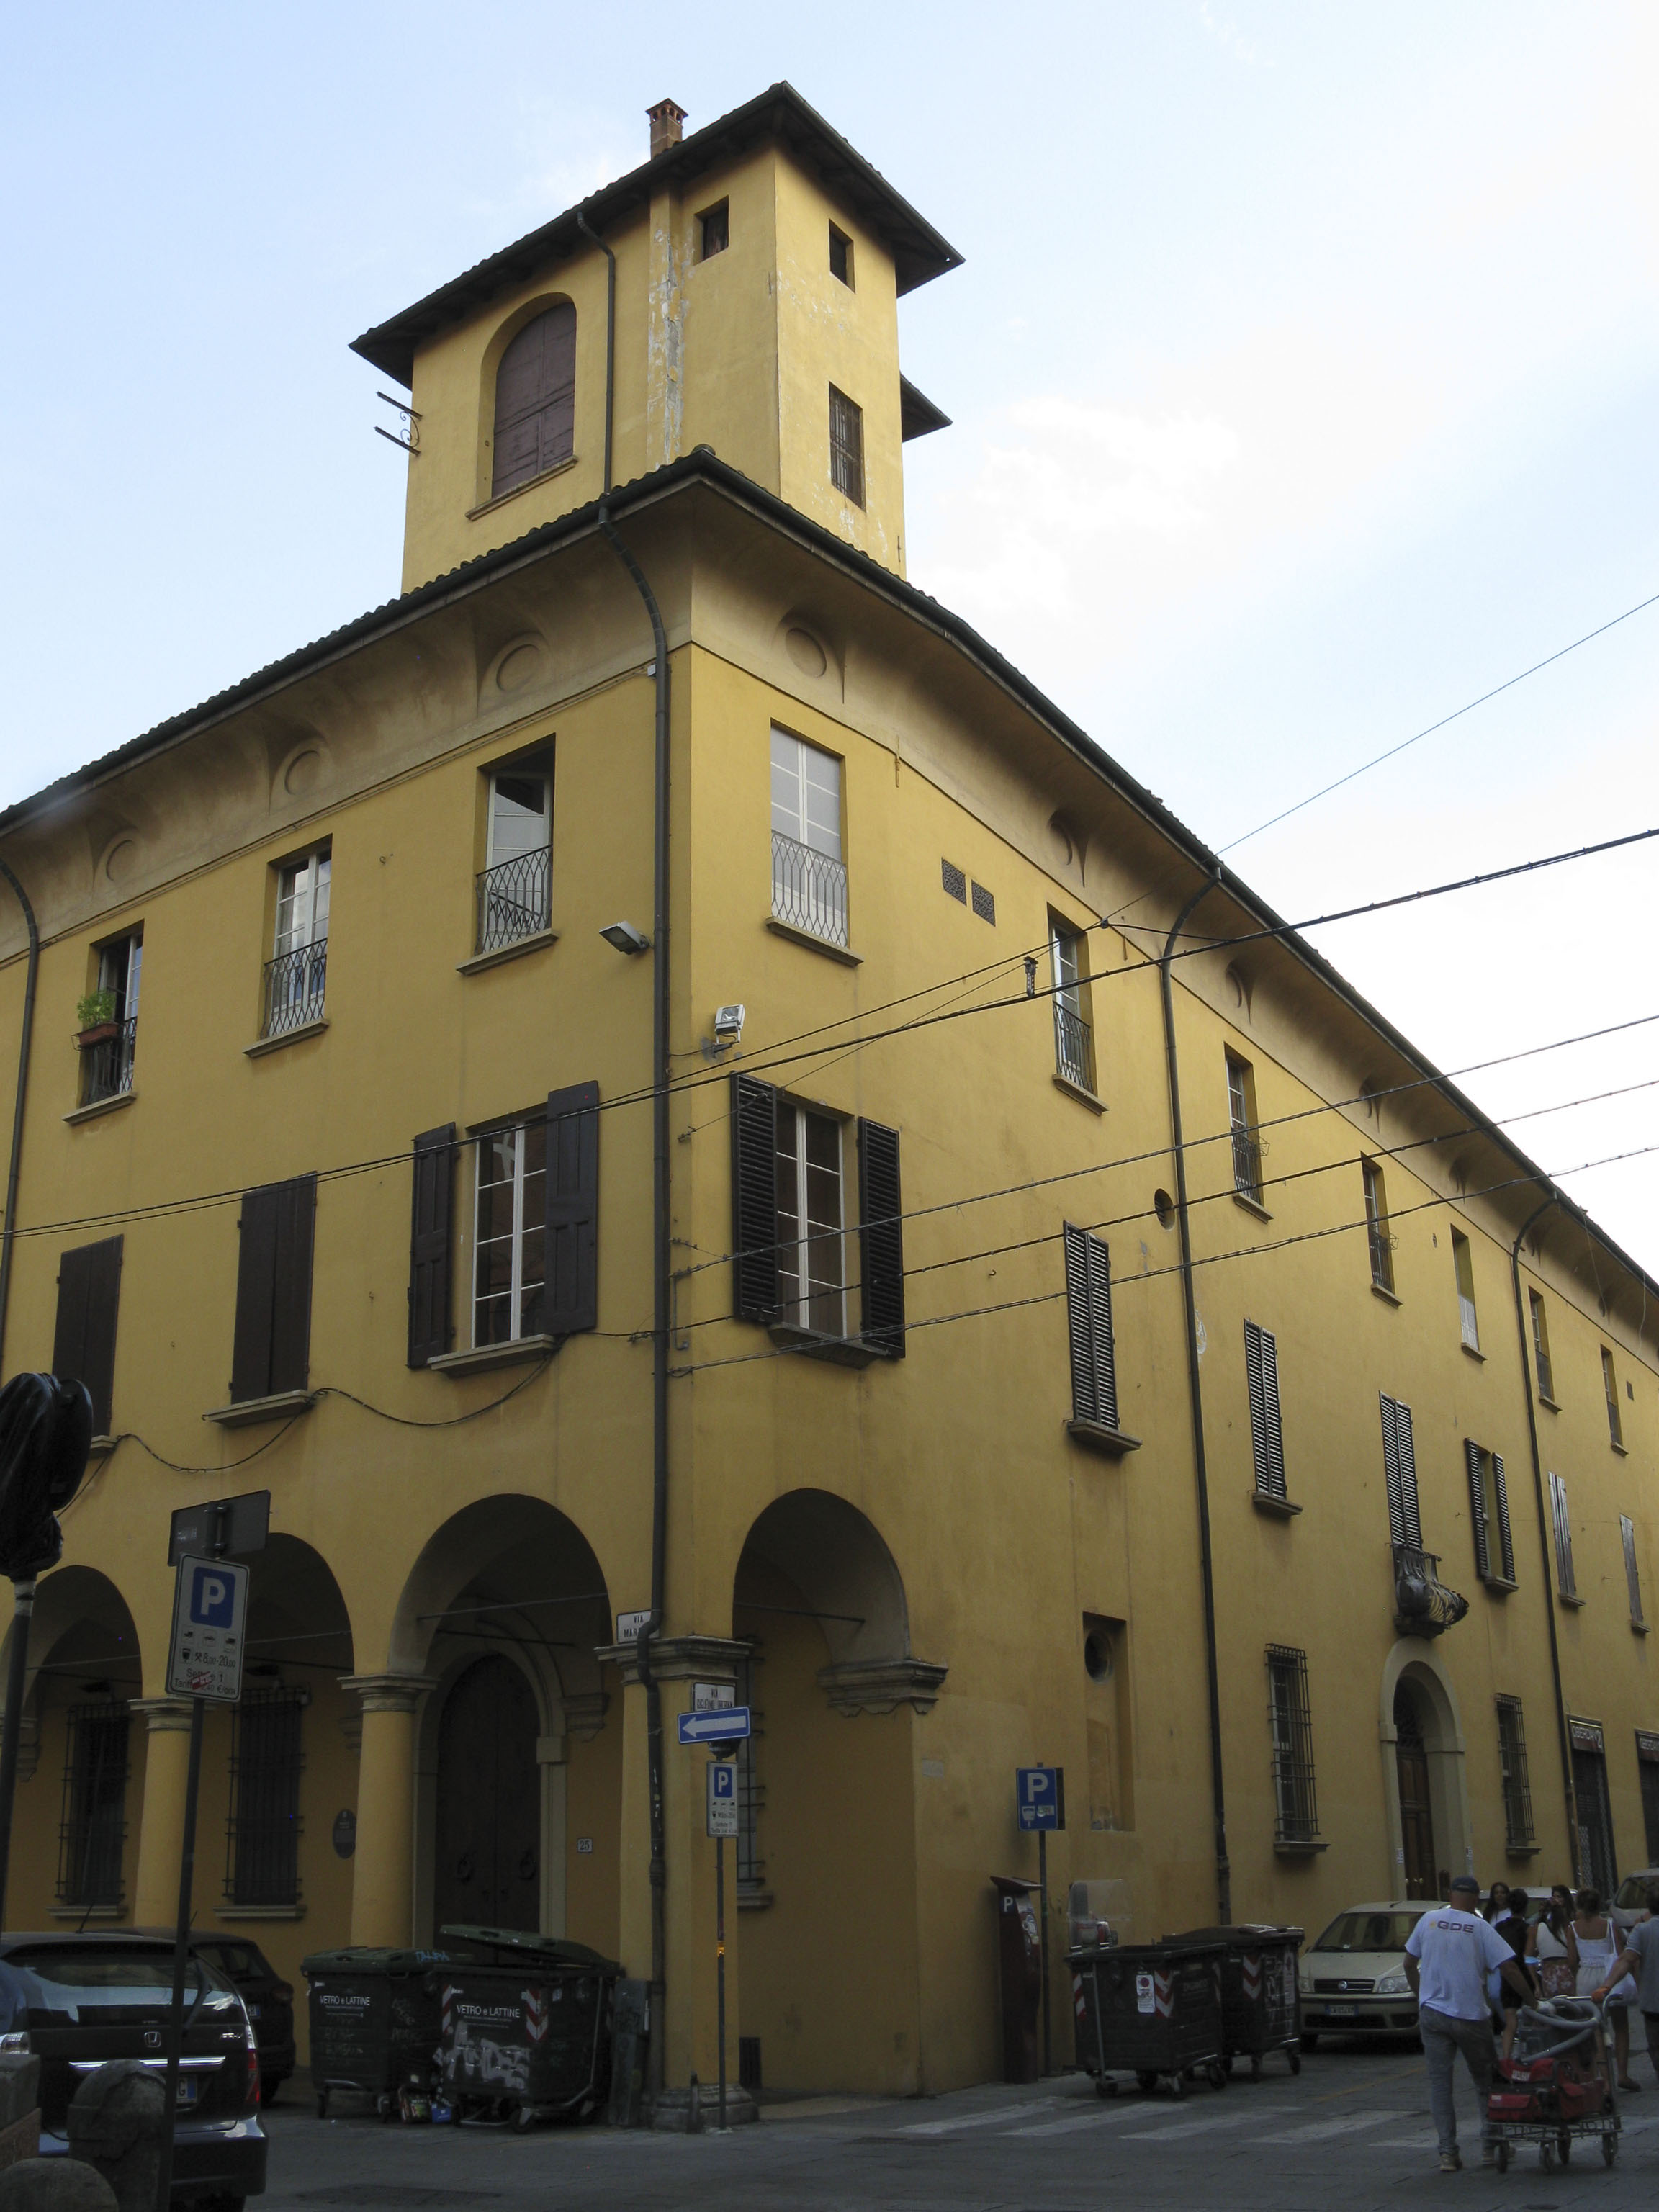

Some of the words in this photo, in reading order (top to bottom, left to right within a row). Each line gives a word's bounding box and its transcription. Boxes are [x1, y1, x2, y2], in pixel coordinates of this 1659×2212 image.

[201, 1576, 226, 1616] P
[624, 1628, 639, 1637] MAR
[718, 1771, 729, 1793] P
[1027, 1773, 1048, 1802] P
[580, 1840, 590, 1851] 25
[1004, 1897, 1013, 1912] P
[1437, 1920, 1474, 1933] GDE
[320, 1995, 340, 2005] VETRO
[346, 1996, 371, 2006] LATTINE
[457, 2005, 481, 2015] VETRO
[489, 2007, 521, 2018] LATTINE
